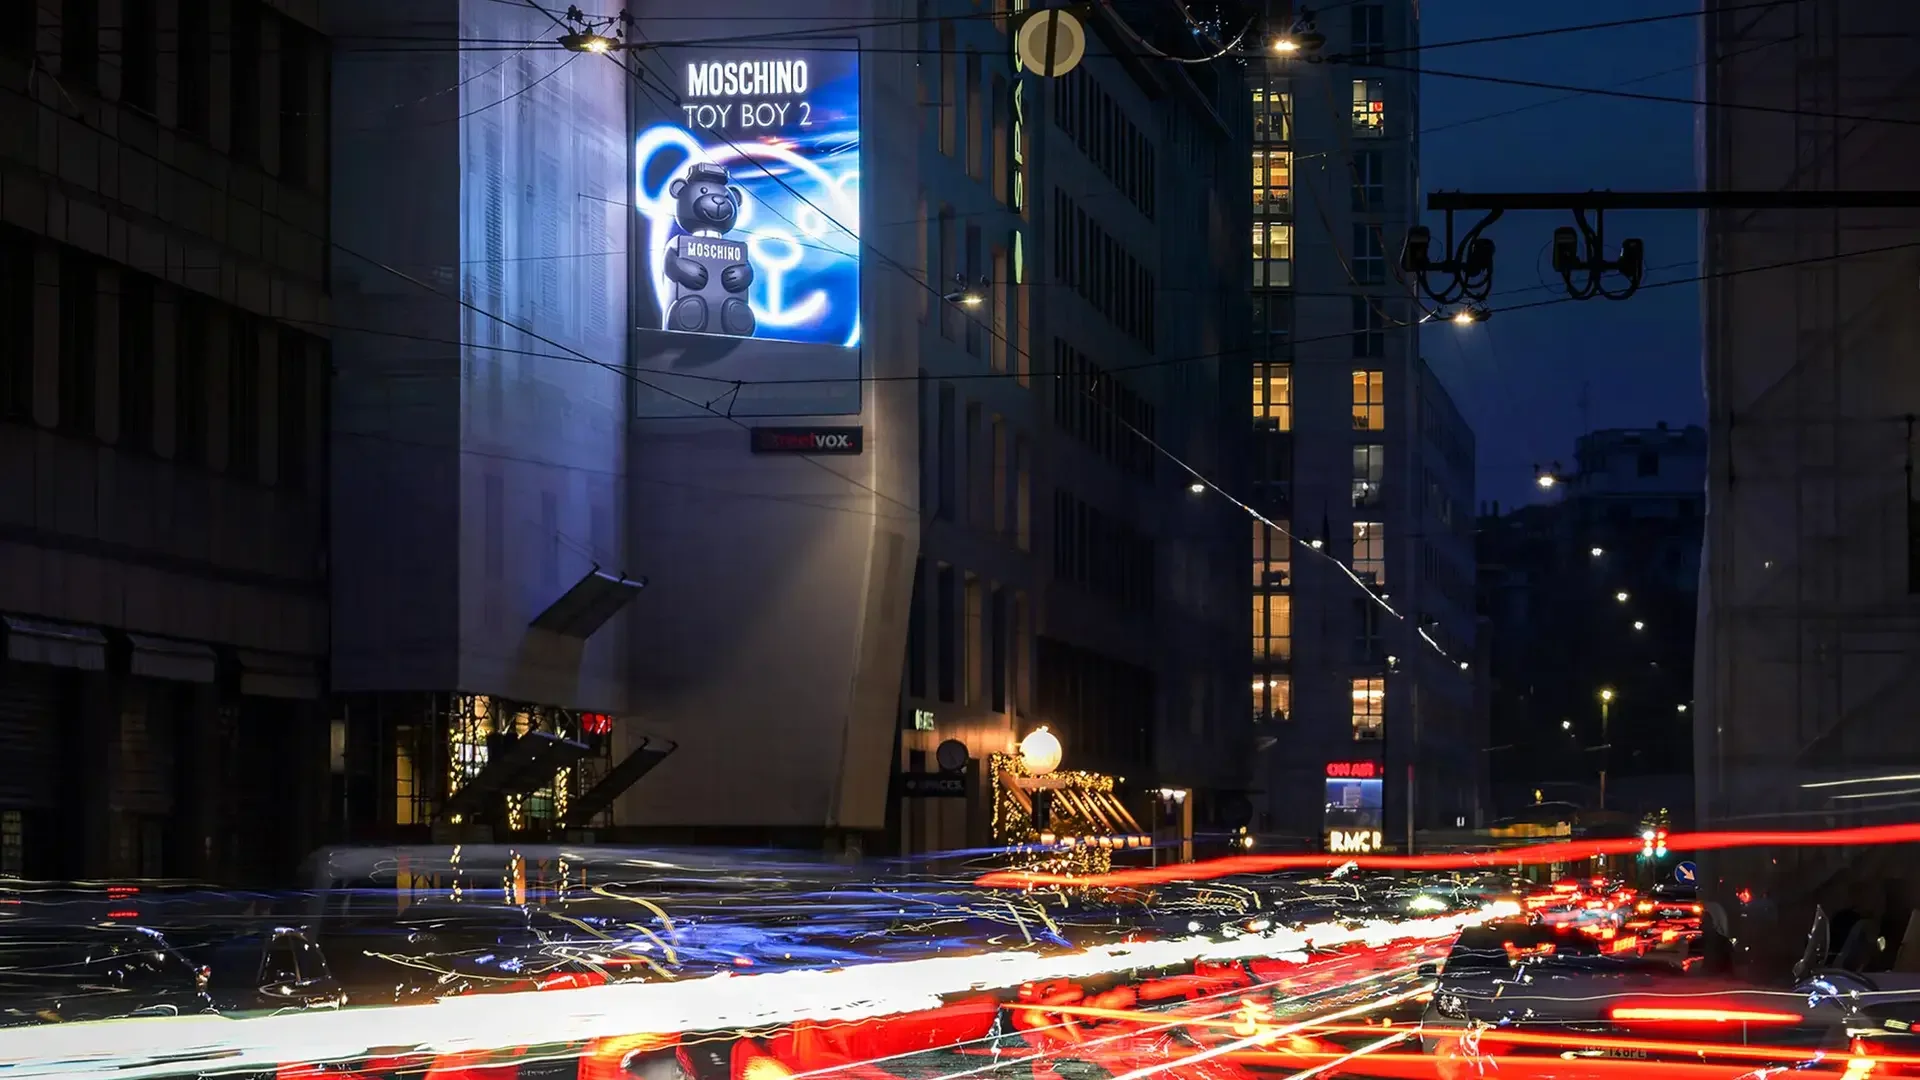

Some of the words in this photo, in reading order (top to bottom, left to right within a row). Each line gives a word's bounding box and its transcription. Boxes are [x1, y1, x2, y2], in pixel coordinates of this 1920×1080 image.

[688, 60, 808, 97] MOSCHINO
[683, 104, 732, 129] TOY
[742, 102, 790, 127] BOY
[799, 101, 812, 126] 2
[687, 241, 741, 261] MOSCHINO
[1326, 763, 1350, 776] ON
[1351, 763, 1374, 776] AIR
[1330, 831, 1371, 852] RMC
